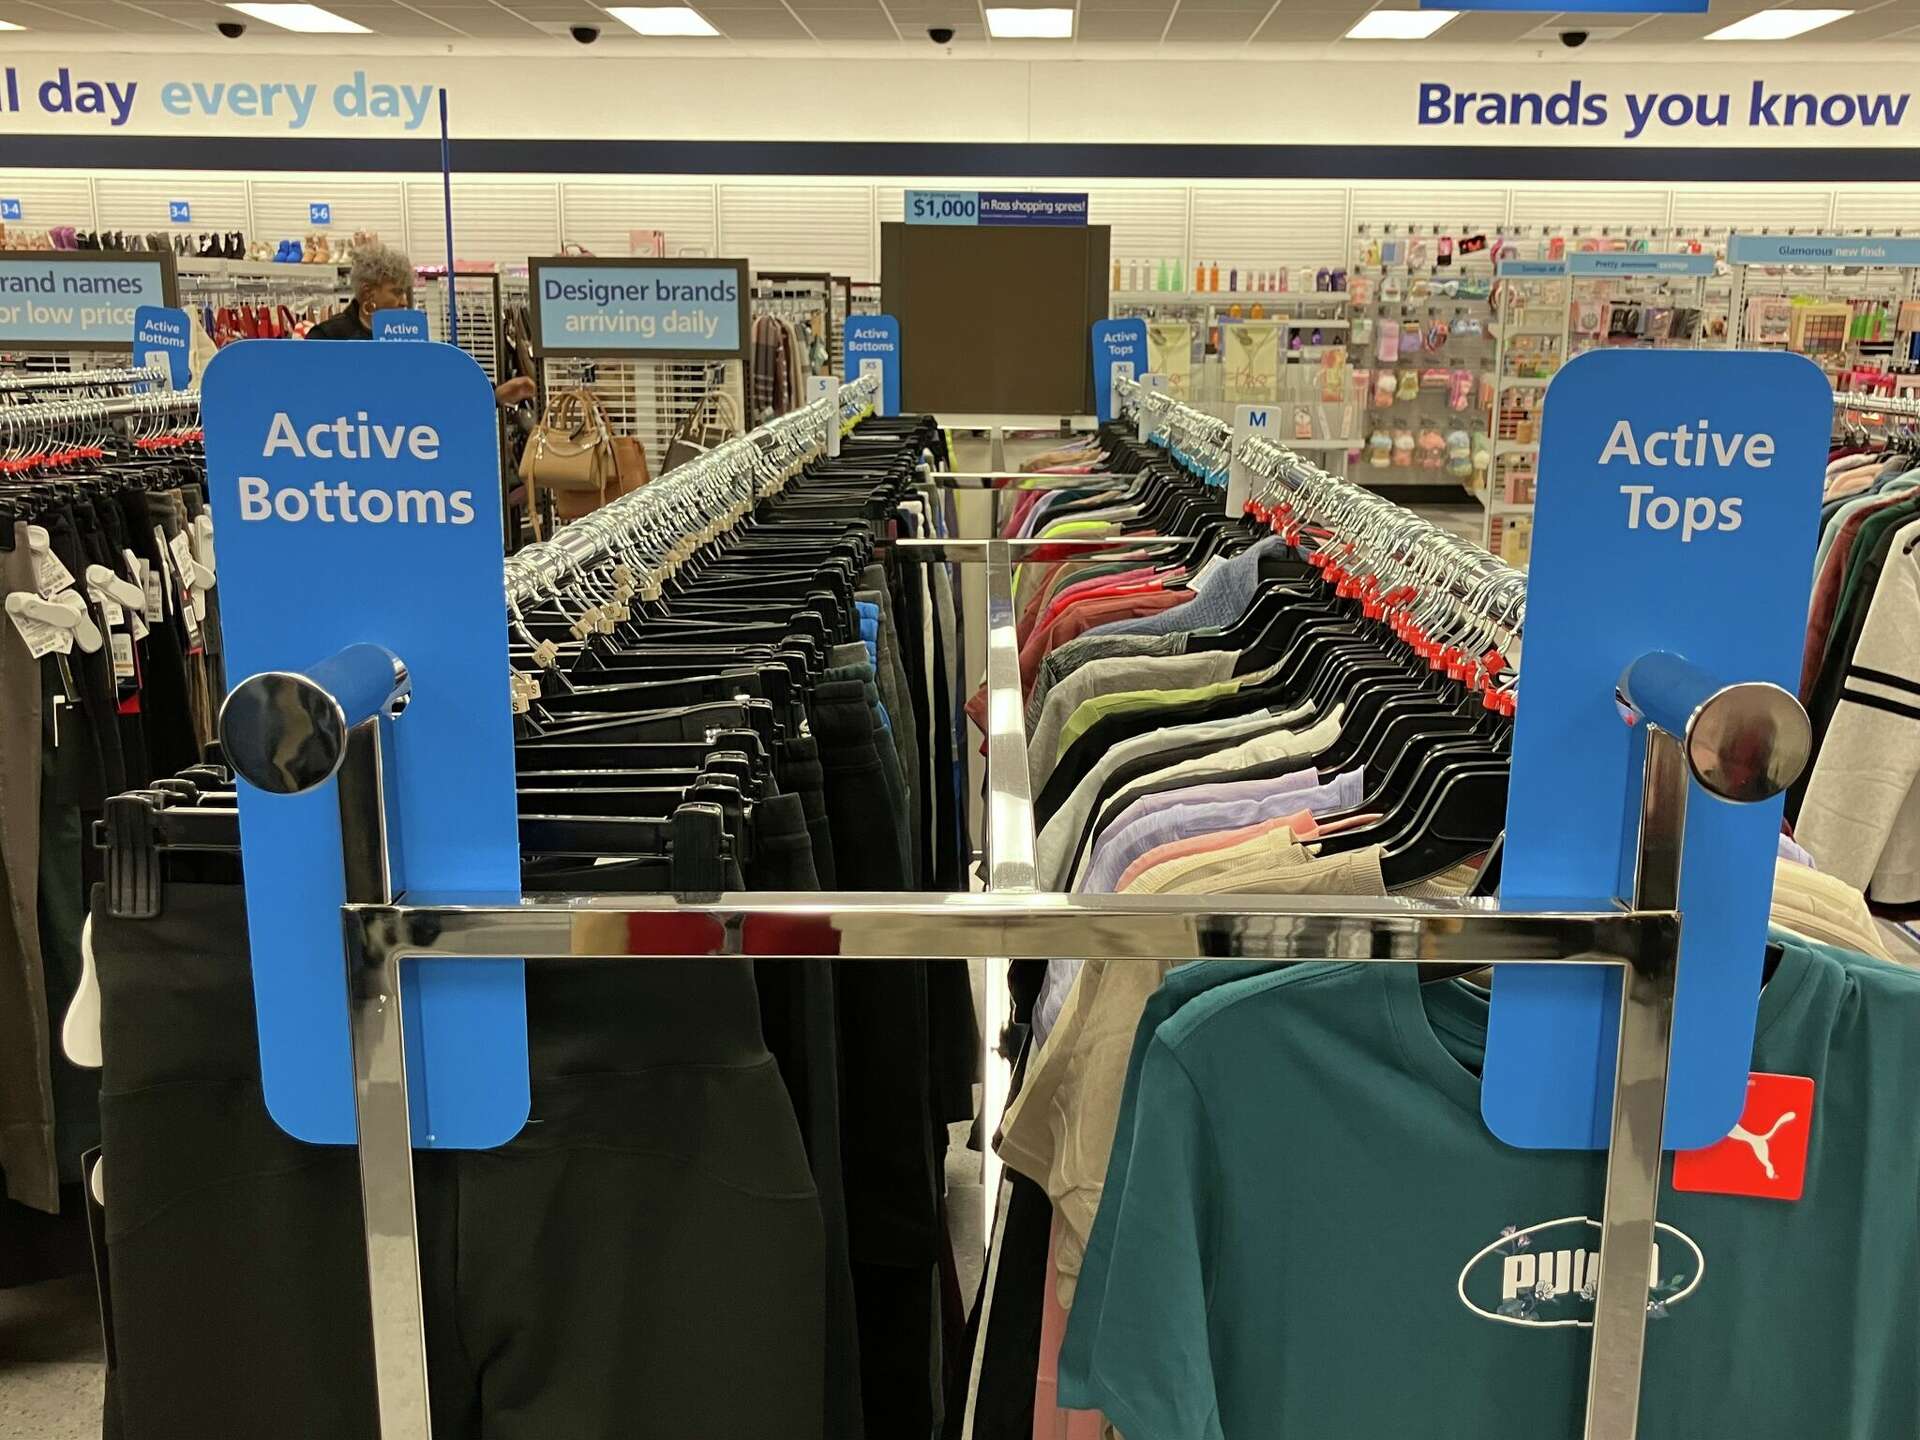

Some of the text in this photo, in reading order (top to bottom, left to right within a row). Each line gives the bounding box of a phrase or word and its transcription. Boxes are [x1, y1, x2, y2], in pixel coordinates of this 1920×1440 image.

[0, 67, 434, 130] l day every day
[1418, 80, 1912, 139] Brands you know
[311, 207, 328, 220] 5-6
[914, 198, 976, 219] $1,000
[980, 199, 1086, 214] in Ross shopping sprees!
[1778, 245, 1886, 257] Glamorous new finds
[0, 271, 143, 294] rand names
[545, 279, 736, 307] Designer brands
[0, 300, 135, 330] or low price
[565, 309, 719, 339] arriving daily
[145, 319, 180, 334] Active
[384, 323, 419, 335] Active
[854, 328, 889, 339] Active
[139, 331, 185, 348] Bottoms
[848, 340, 894, 352] Bottoms
[1104, 331, 1138, 343] Active
[1108, 344, 1134, 357] Tops
[819, 380, 826, 390] S
[1249, 411, 1267, 427] M
[262, 411, 440, 461] Active
[1598, 419, 1776, 469] Active
[238, 475, 475, 525] Bottoms
[1620, 485, 1743, 542] Tops
[1502, 1243, 1660, 1300] PU
